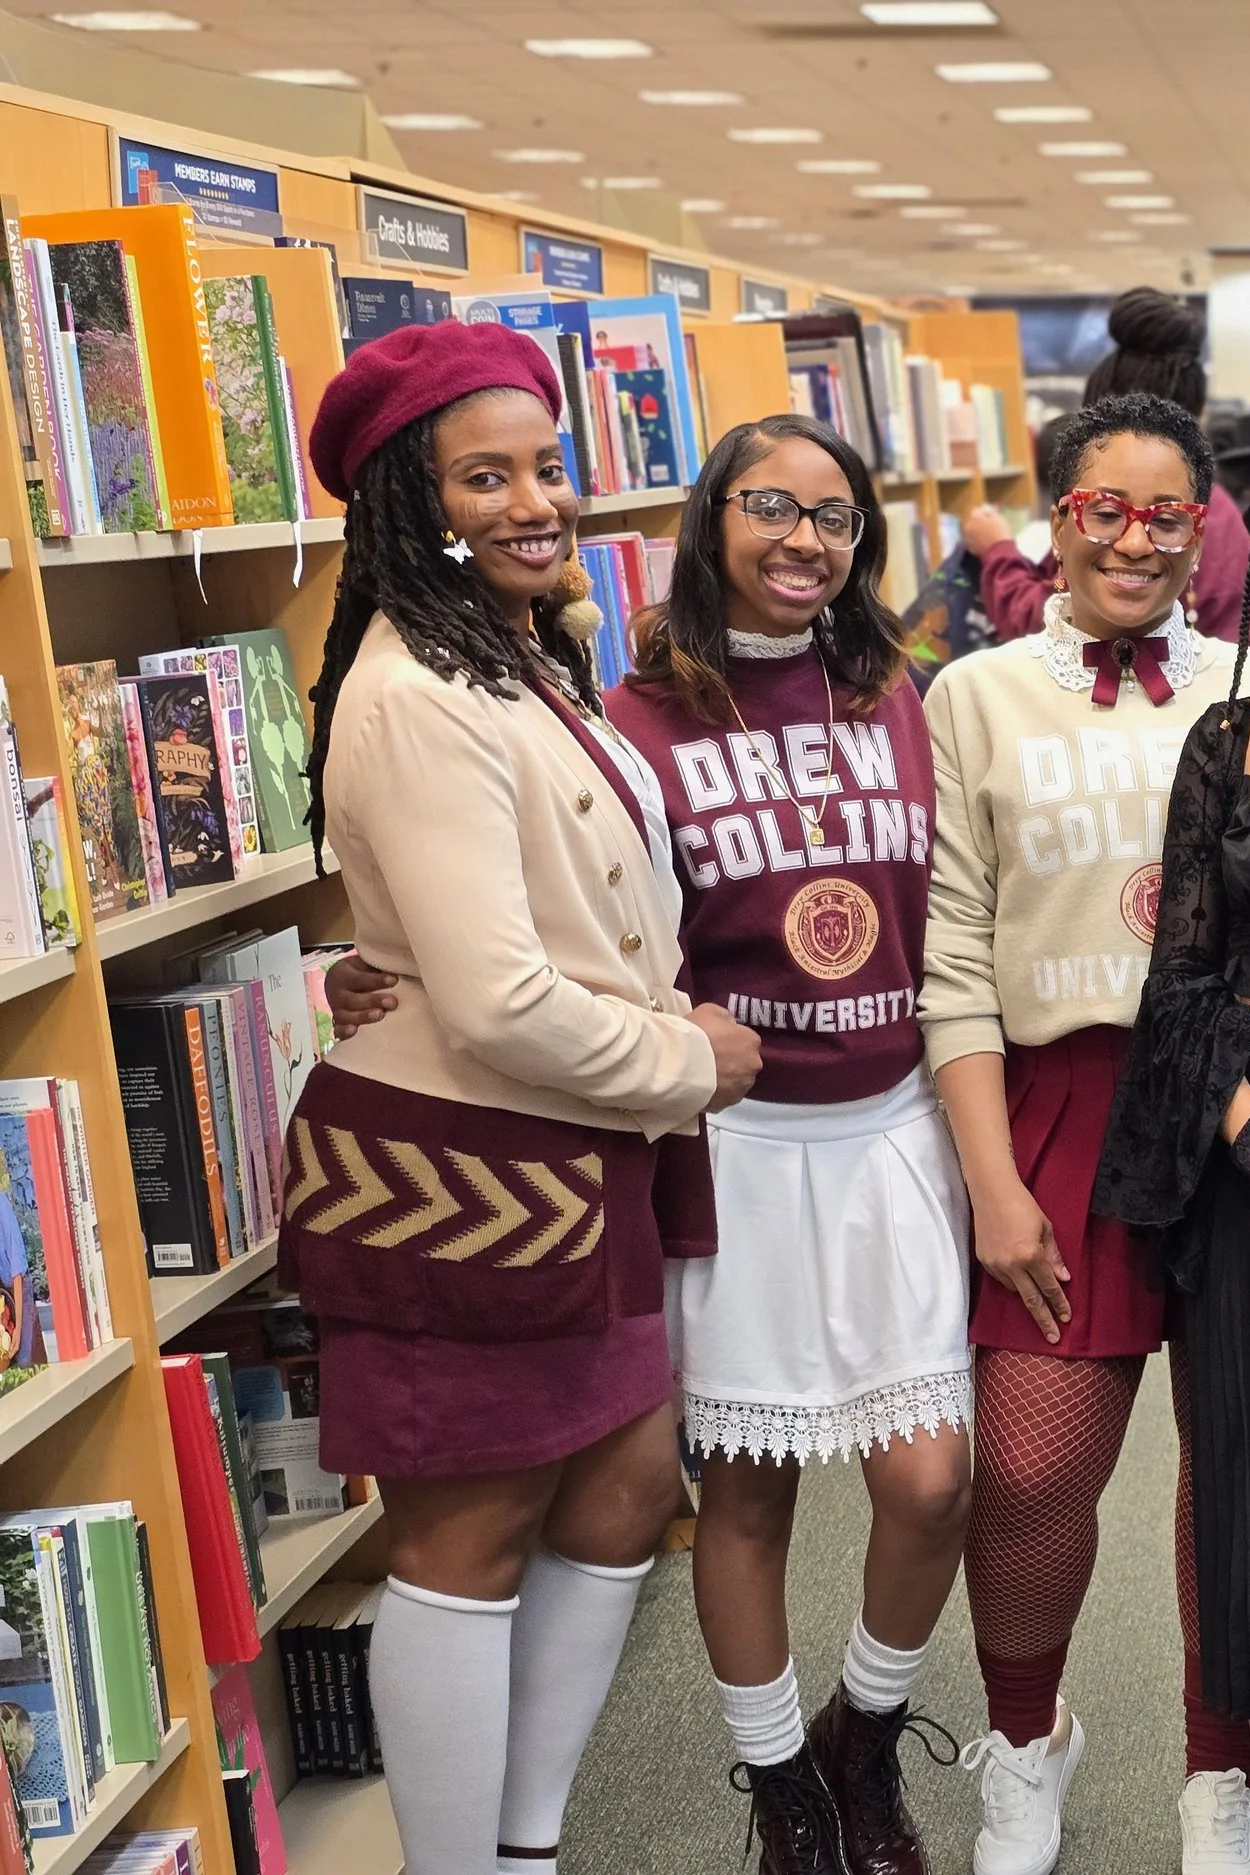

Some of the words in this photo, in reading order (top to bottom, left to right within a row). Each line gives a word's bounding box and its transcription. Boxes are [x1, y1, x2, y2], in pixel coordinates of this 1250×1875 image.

[175, 163, 210, 184] MEMBERS
[210, 170, 230, 188] EARN
[230, 175, 256, 194] STAMPS
[378, 215, 405, 245] Crafts
[407, 220, 416, 237] &
[416, 222, 450, 253] Hobbies
[183, 216, 212, 364] FLOWER
[356, 302, 376, 314] Dimes
[508, 307, 543, 316] STORAGE
[5, 219, 32, 348] LANDSCAPE
[25, 354, 45, 433] DESIGN
[470, 308, 494, 317] MULTI
[514, 316, 539, 326] PAGES
[50, 321, 58, 340] The
[54, 346, 64, 380] Earth
[157, 750, 207, 771] RAPHY
[671, 723, 897, 812] DREW
[5, 749, 24, 822] bonsai
[674, 800, 929, 888] COLLINS
[804, 883, 830, 895] Collins
[834, 882, 870, 908] University
[268, 974, 282, 991] The
[727, 988, 915, 1033] UNIVERSITY
[206, 1014, 228, 1122] PEONIES
[236, 1002, 254, 1088] VINTAGE
[249, 1096, 262, 1155] ROSES
[254, 996, 278, 1132] RANUNCULUS
[187, 1025, 219, 1176] DAFFODILS
[78, 1123, 88, 1166] WINTER
[85, 1168, 94, 1215] GARDEN
[61, 1578, 69, 1604] HOW
[65, 1608, 71, 1621] TO
[67, 1624, 77, 1665] CREATE
[134, 1571, 148, 1632] URBAN
[141, 1638, 158, 1723] BOTANICS
[339, 1653, 351, 1685] getting
[77, 1699, 87, 1747] GARDEN
[343, 1688, 354, 1715] baked
